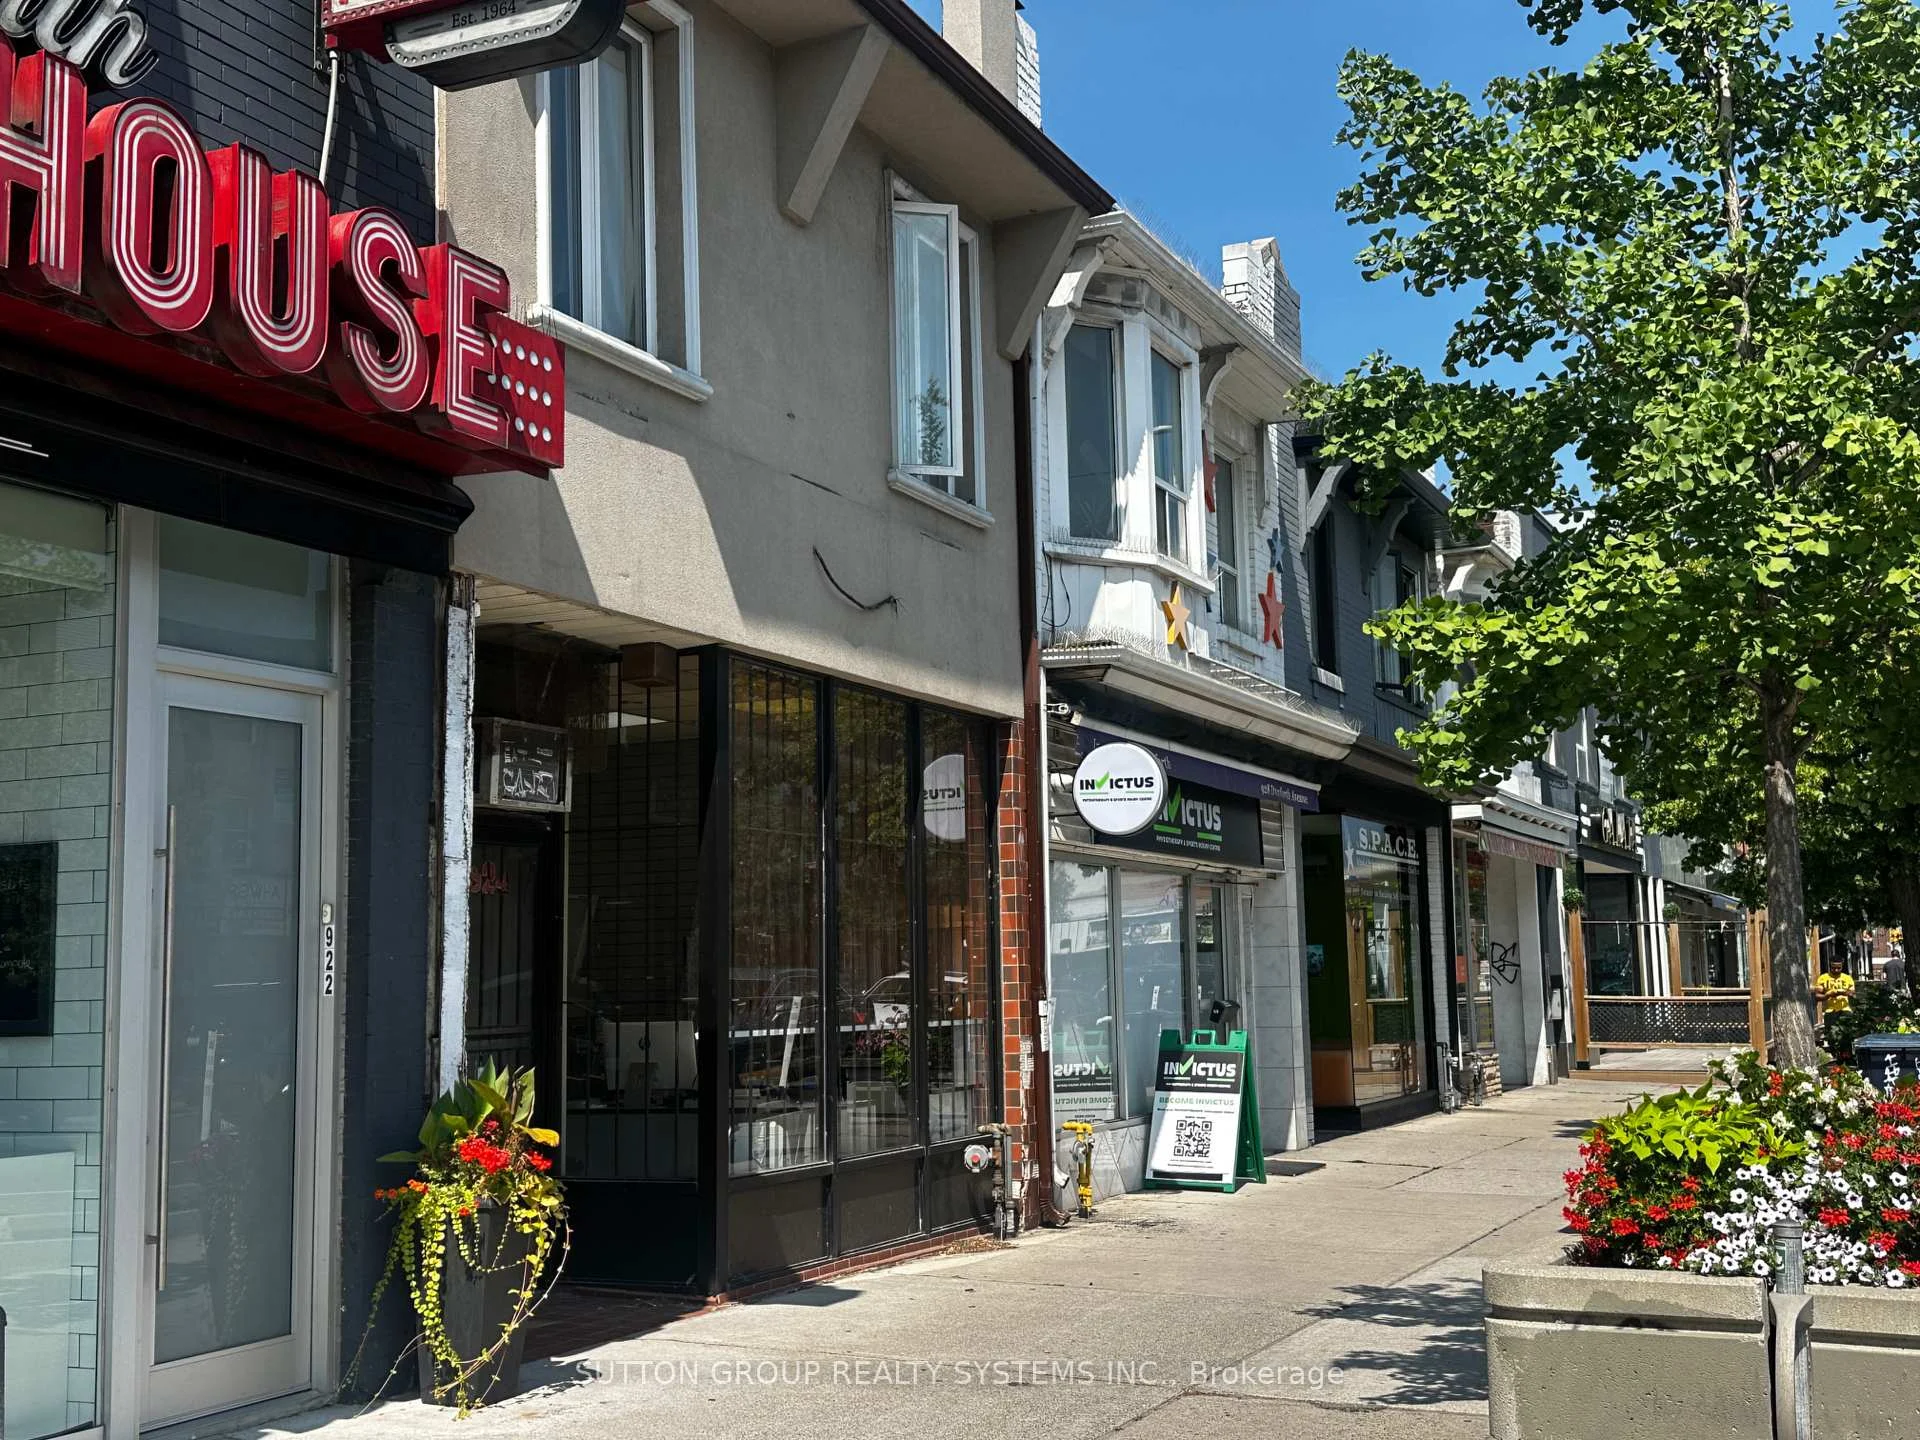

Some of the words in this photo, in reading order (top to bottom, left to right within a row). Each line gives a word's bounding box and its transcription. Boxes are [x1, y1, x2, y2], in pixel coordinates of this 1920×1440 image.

[451, 11, 477, 28] Est.
[481, 2, 516, 21] 1964
[0, 30, 509, 449] HOUSE
[1079, 771, 1154, 791] INVICTUS
[1159, 783, 1222, 832] VICTUS
[1359, 828, 1419, 860] S.P.A.C.E.
[325, 926, 333, 995] 922
[1163, 1054, 1237, 1077] INVICTUS
[1159, 1096, 1194, 1105] BECOME
[1195, 1097, 1235, 1106] INVICTUS
